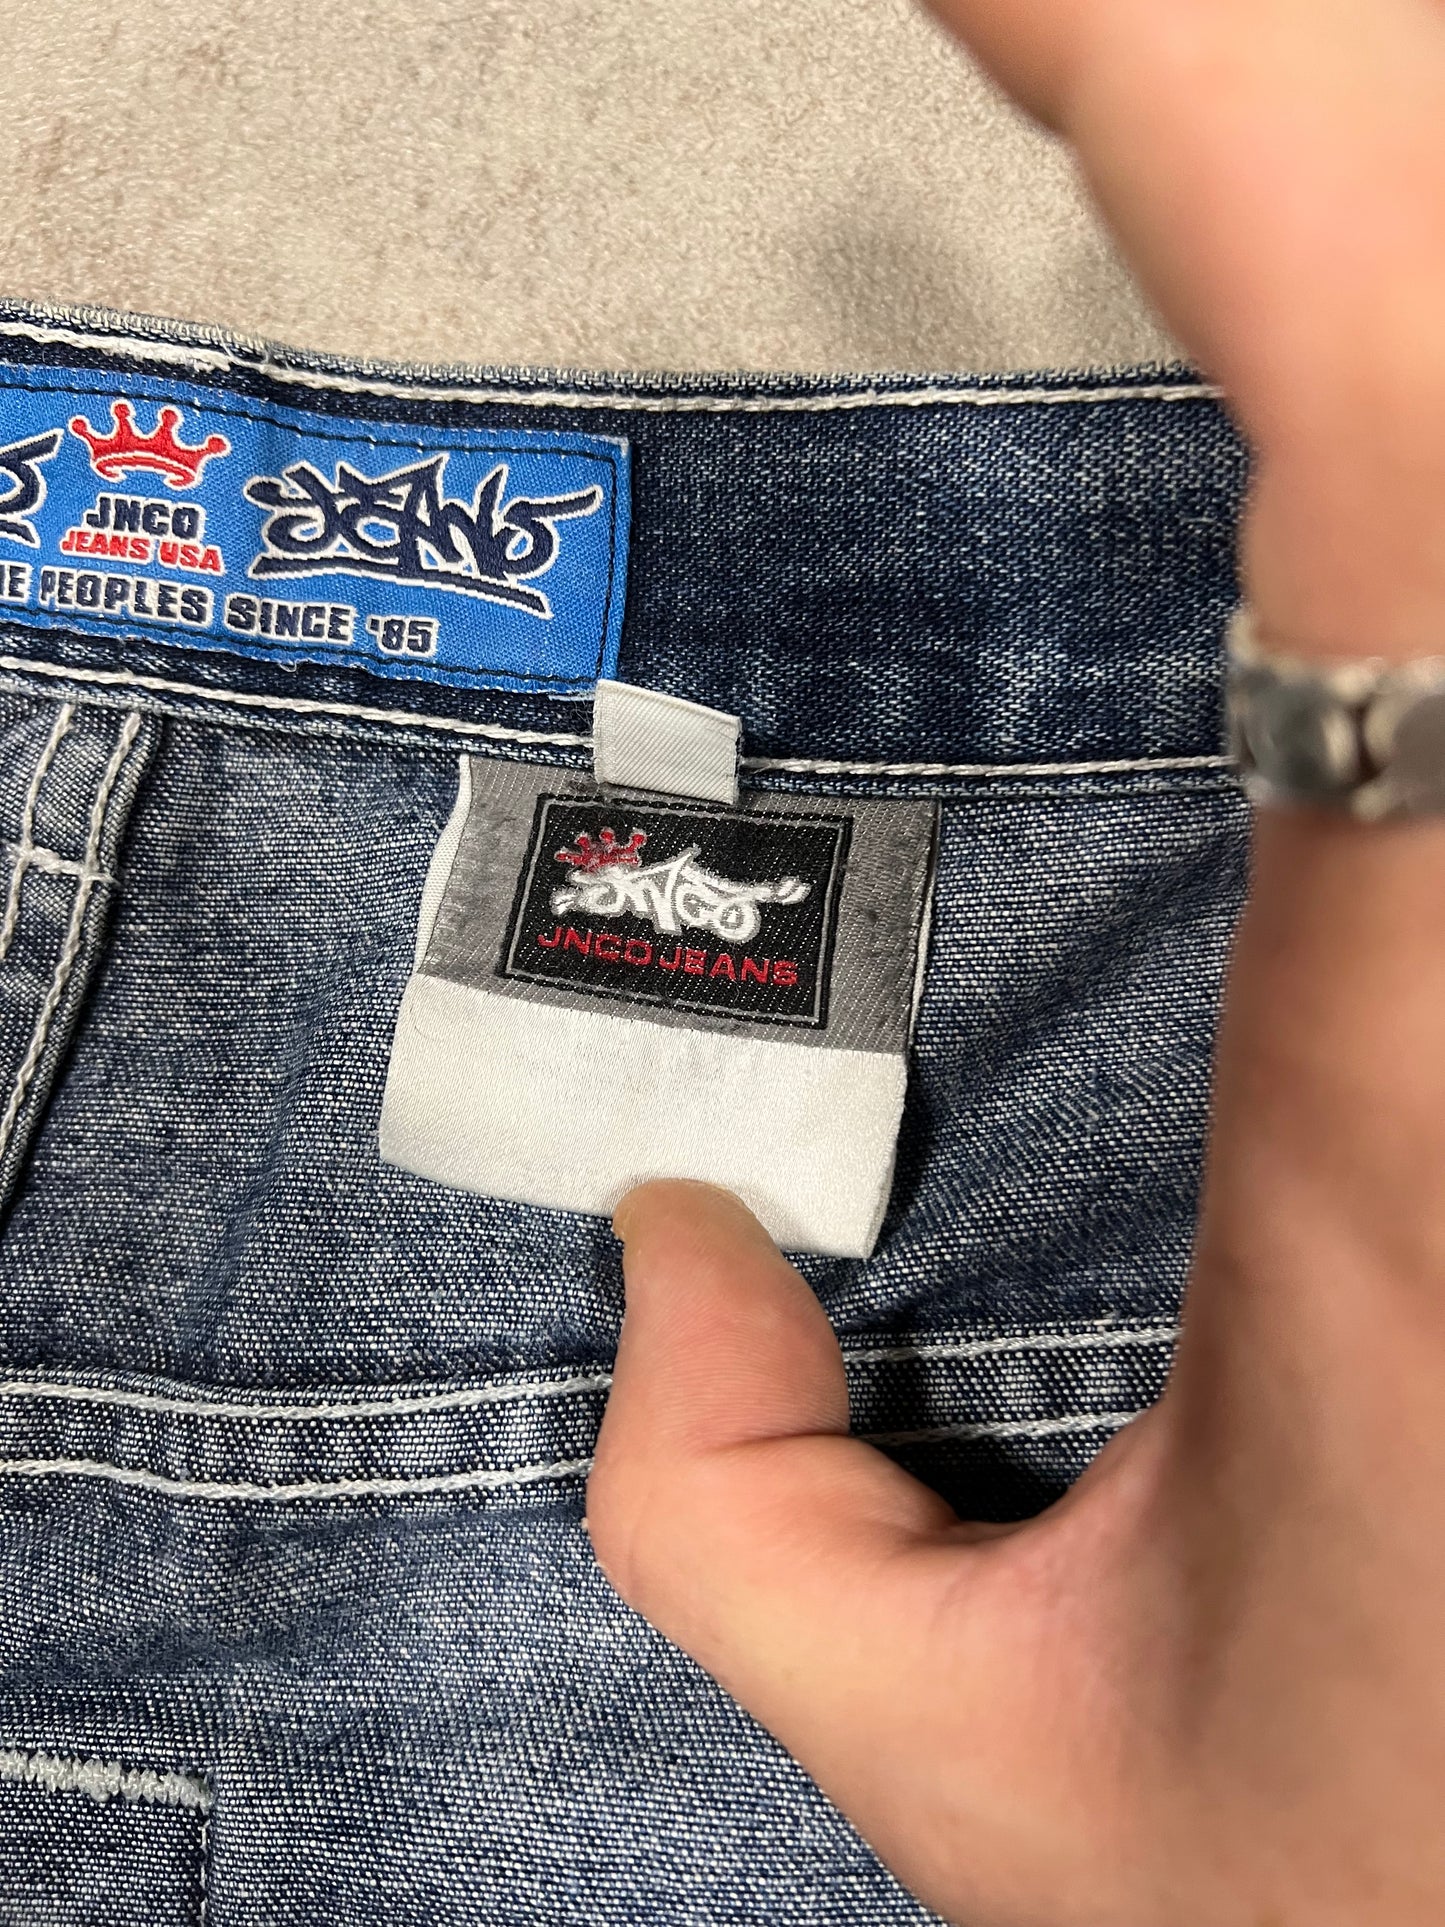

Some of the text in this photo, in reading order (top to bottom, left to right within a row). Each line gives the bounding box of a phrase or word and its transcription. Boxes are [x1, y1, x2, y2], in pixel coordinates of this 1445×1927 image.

[84, 494, 204, 541] JNCO
[61, 529, 223, 573] JEANS USA
[41, 567, 211, 625] PEOPLES
[226, 595, 353, 642] SINCE
[369, 616, 437, 656] '85
[538, 927, 799, 987] JNCO JEANS
